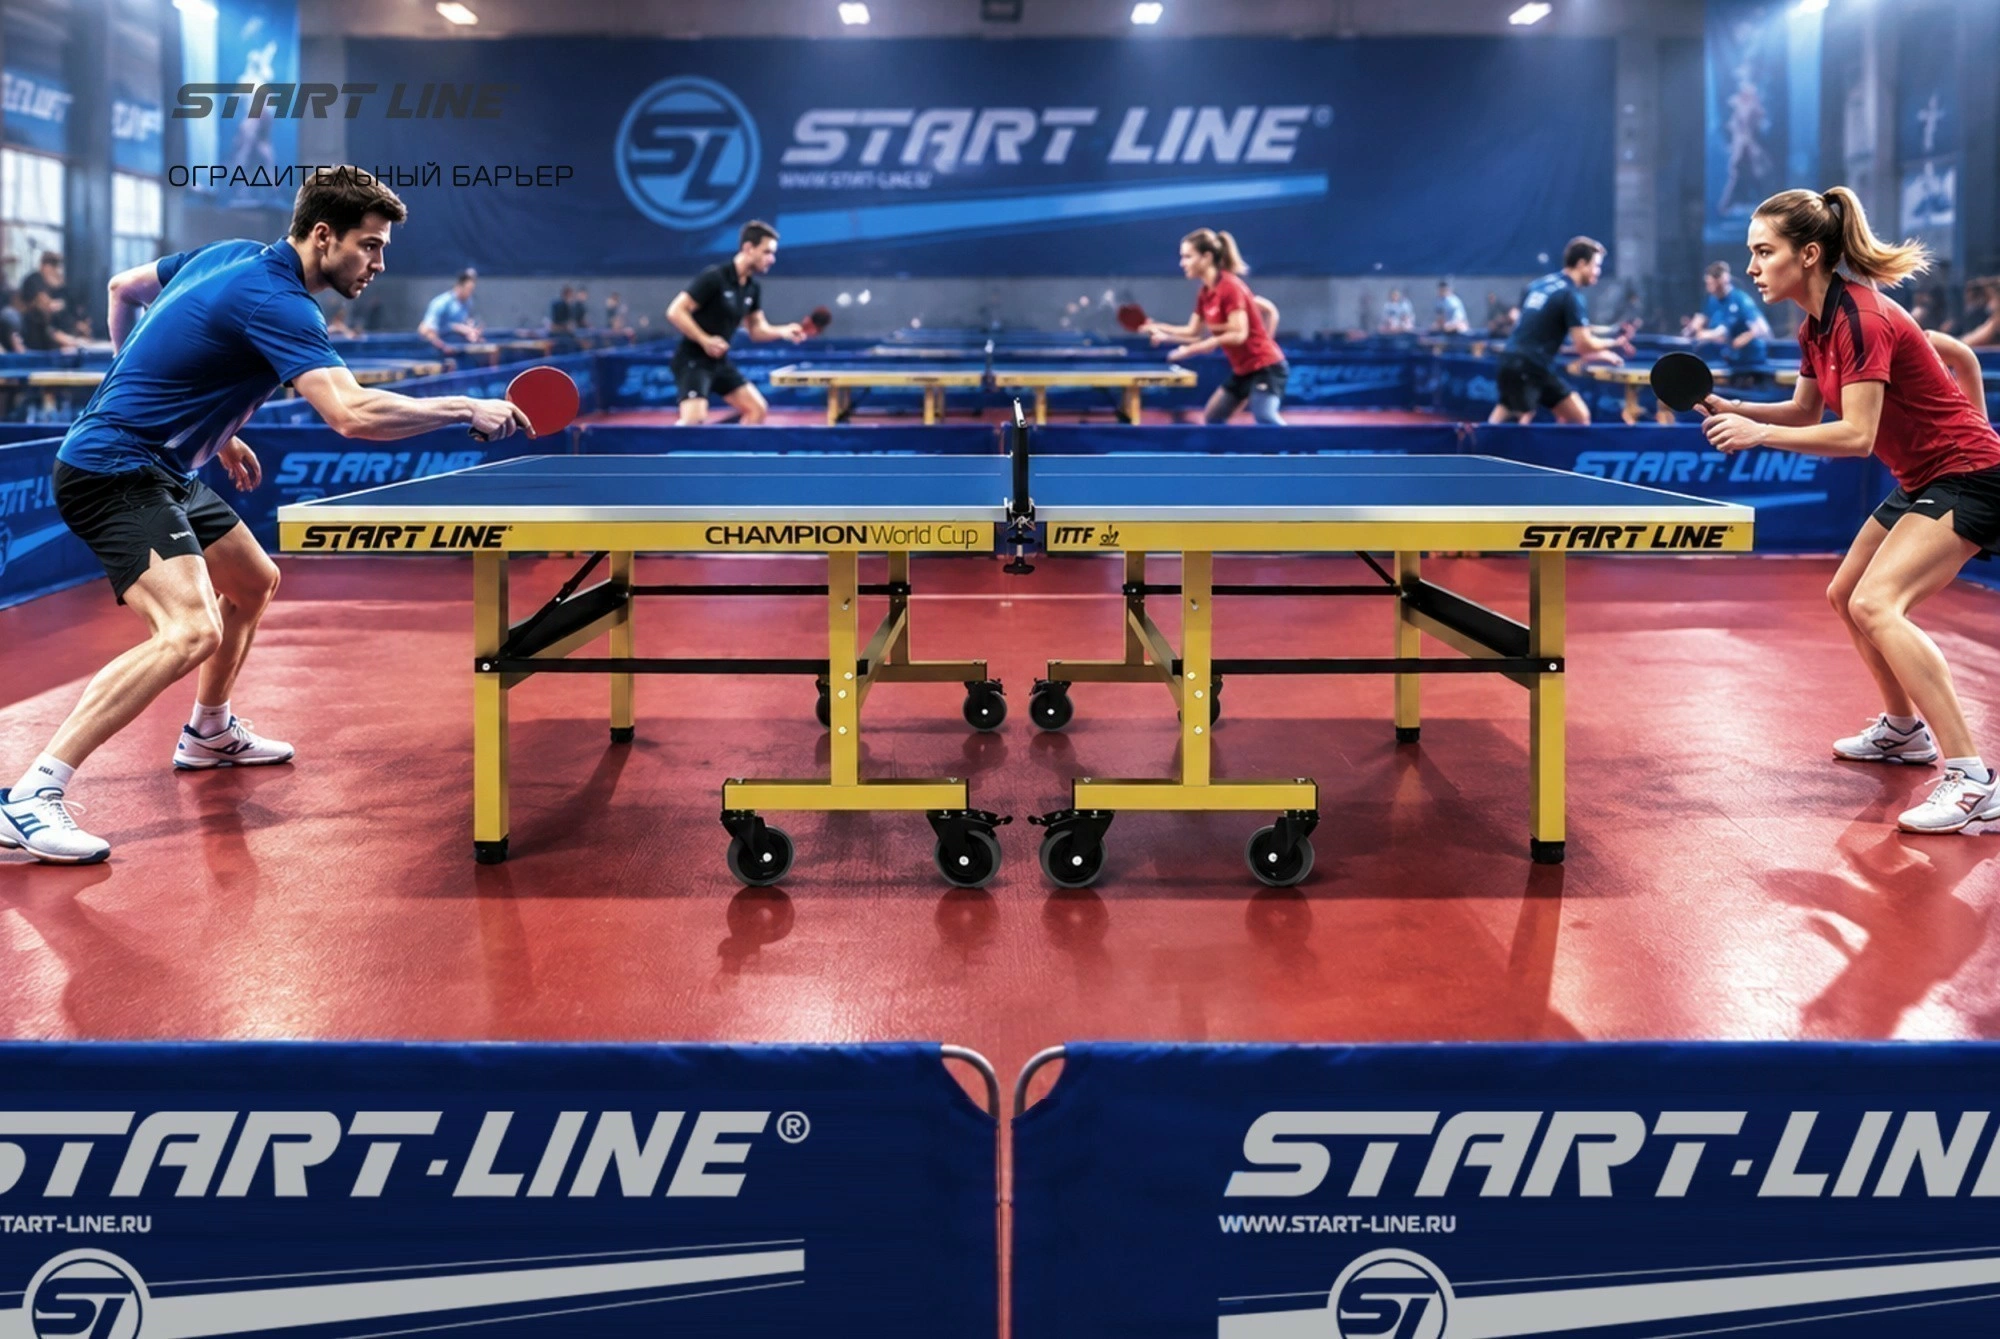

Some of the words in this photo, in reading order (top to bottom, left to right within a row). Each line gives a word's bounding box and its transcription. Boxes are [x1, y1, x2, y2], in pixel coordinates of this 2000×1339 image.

[781, 107, 1098, 165] START
[1106, 106, 1313, 164] LINE
[275, 452, 411, 484] START
[302, 525, 427, 549] START
[430, 525, 508, 549] LINE
[705, 525, 868, 545] CHAMPION
[870, 525, 931, 544] World
[937, 525, 979, 549] Cup
[1053, 526, 1095, 544] ITTF
[1519, 525, 1647, 549] START
[1650, 525, 1729, 549] LINE
[0, 1215, 153, 1234] TART-LINE.RU
[1218, 1215, 1457, 1234] WWW.START-LINE.RU
